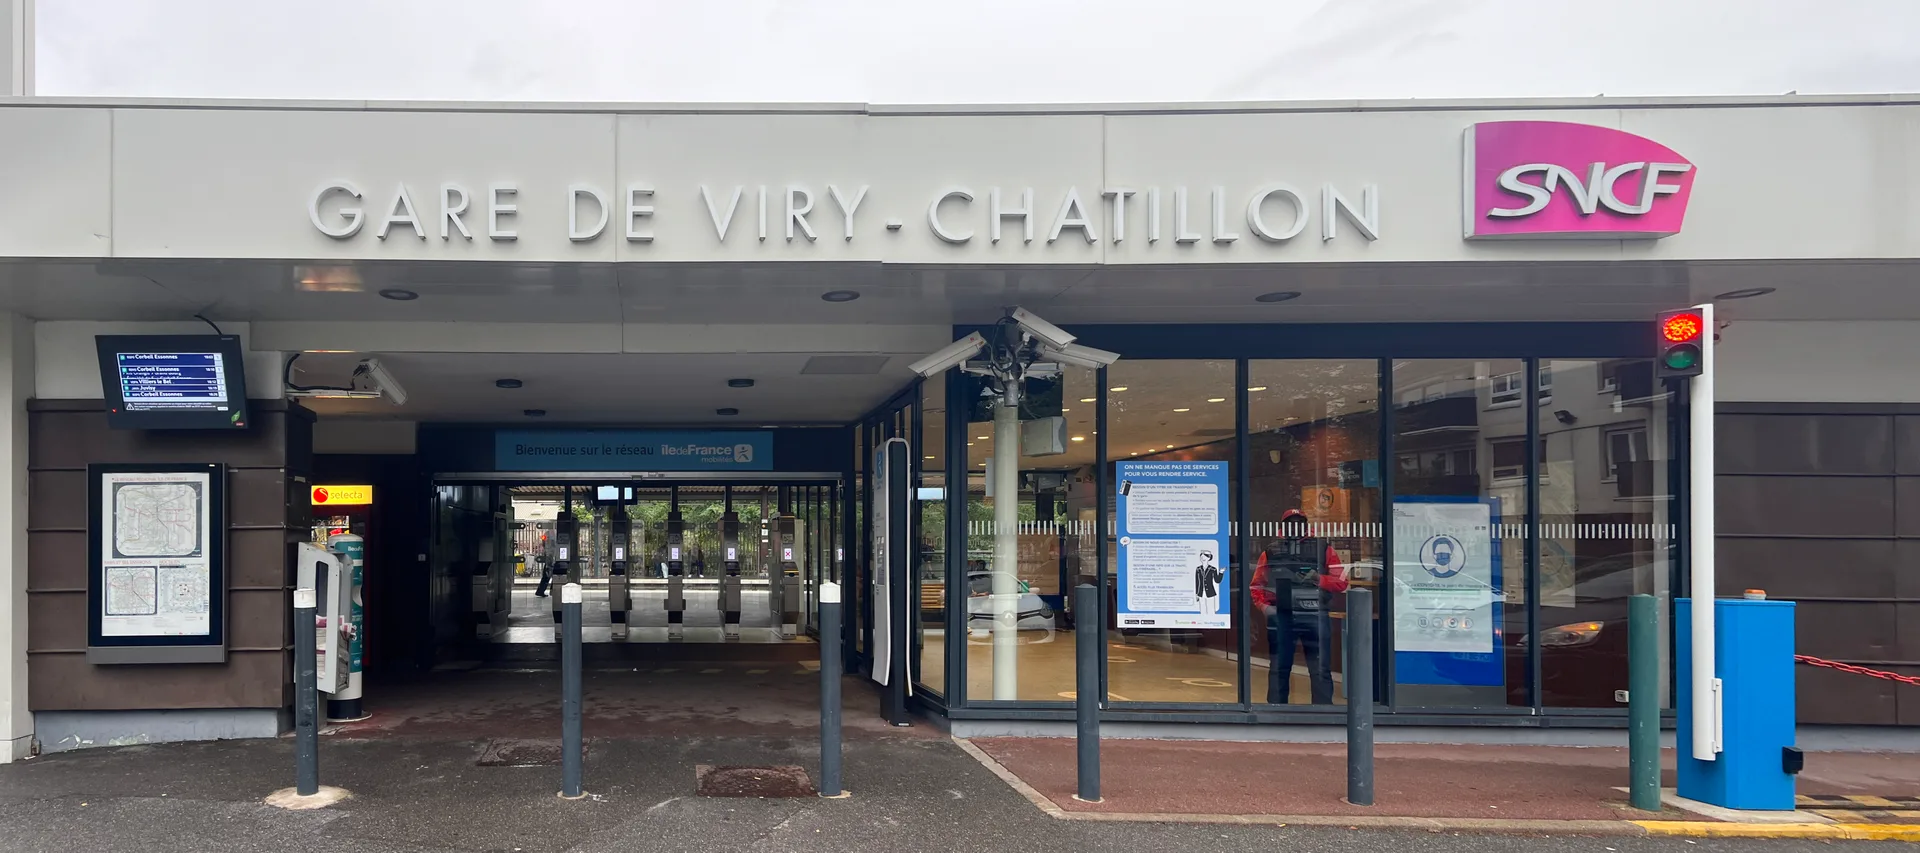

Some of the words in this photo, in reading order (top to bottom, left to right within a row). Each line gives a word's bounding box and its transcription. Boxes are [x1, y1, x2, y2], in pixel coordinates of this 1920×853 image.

[1487, 161, 1692, 219] SNCF
[308, 182, 519, 241] GARE
[568, 184, 655, 242] DE
[700, 184, 869, 243] VIRY
[927, 183, 1378, 244] CHATILLON
[515, 443, 577, 456] Bienvenue
[580, 446, 598, 456] sur
[602, 443, 612, 456] le
[616, 444, 654, 456] réseau
[330, 490, 363, 500] selecta
